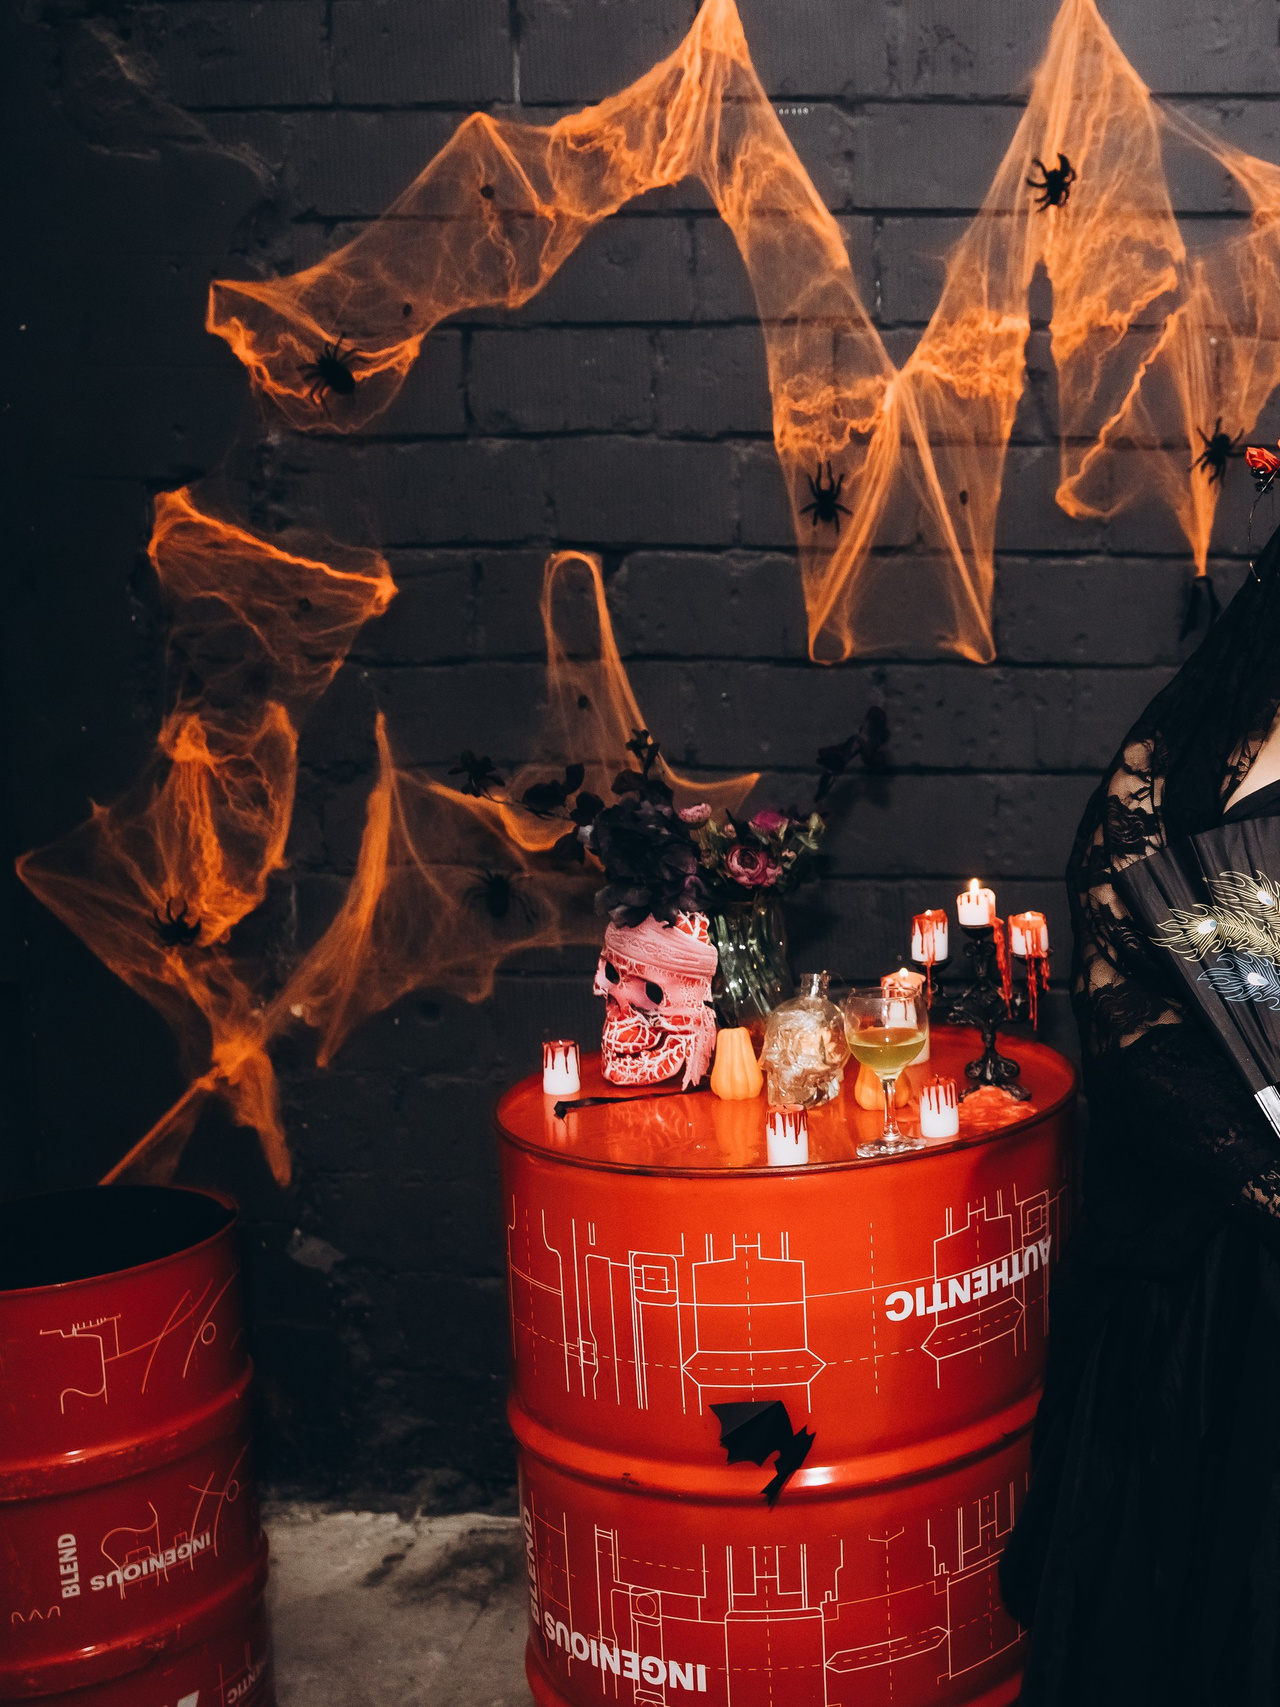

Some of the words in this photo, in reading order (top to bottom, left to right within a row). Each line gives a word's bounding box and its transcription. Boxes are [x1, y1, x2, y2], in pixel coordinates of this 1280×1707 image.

[885, 1235, 1051, 1321] AUTHENTIC
[57, 1533, 81, 1599] BLEND
[90, 1531, 211, 1591] INGENIOUS
[523, 1505, 540, 1626] BLEND
[544, 1611, 707, 1692] INGENIOUS
